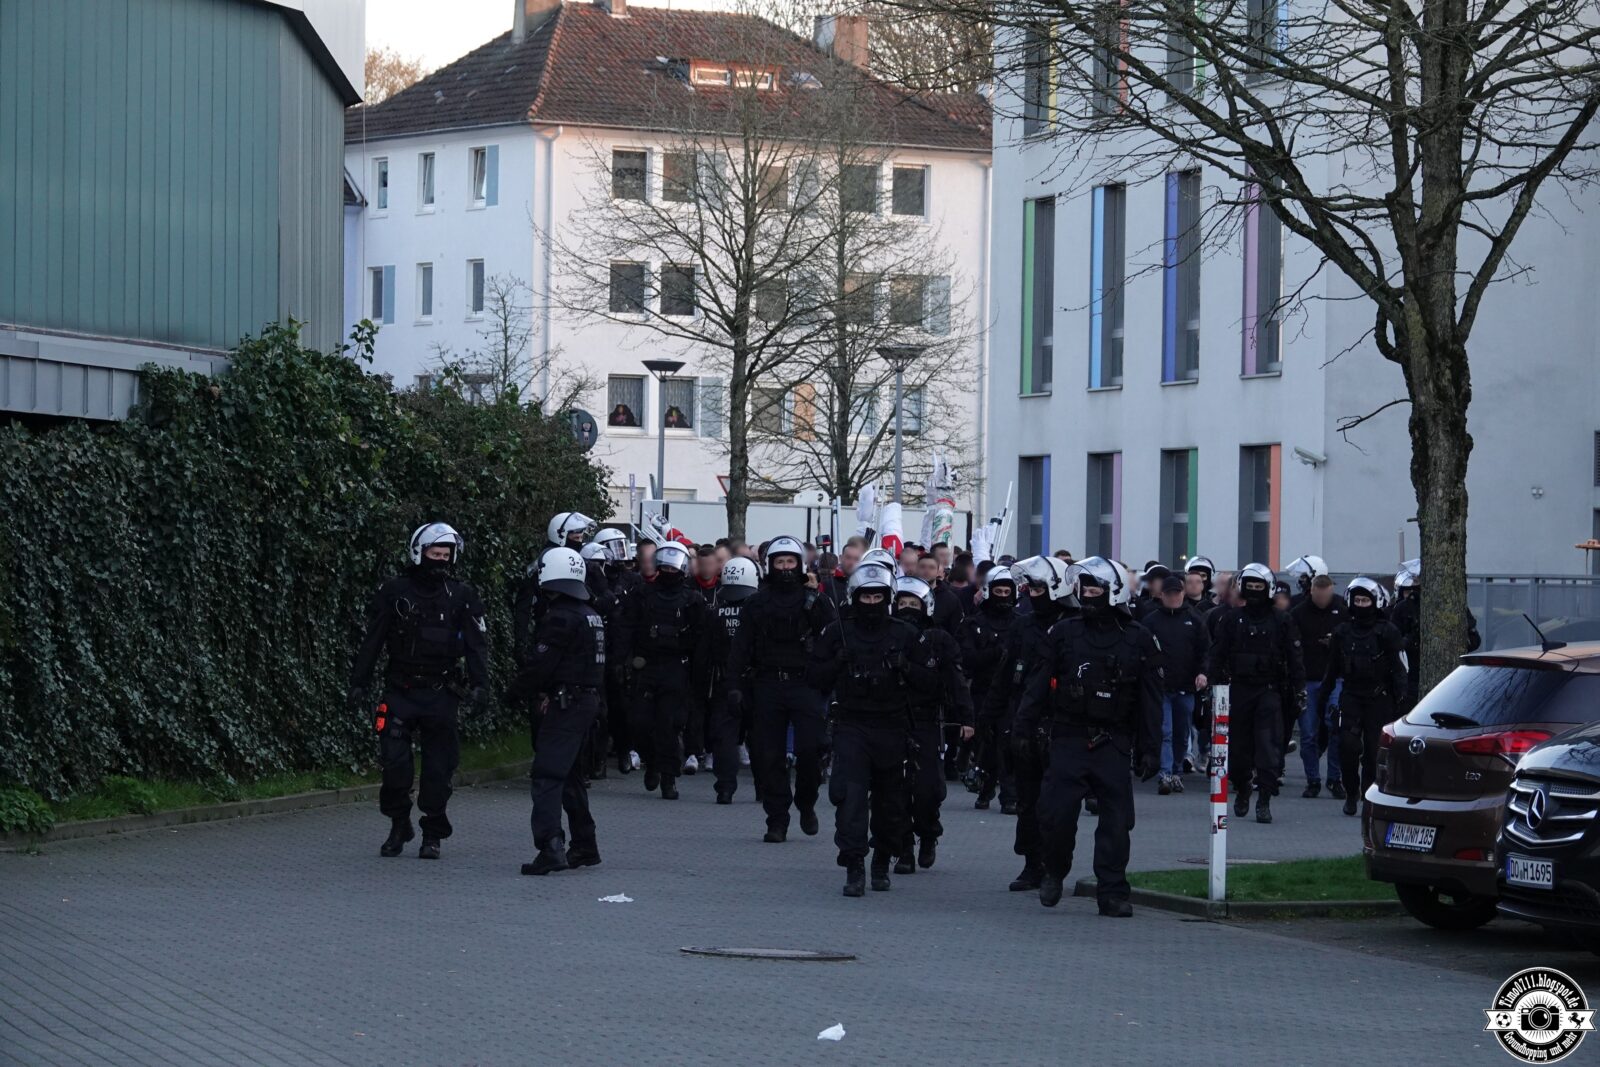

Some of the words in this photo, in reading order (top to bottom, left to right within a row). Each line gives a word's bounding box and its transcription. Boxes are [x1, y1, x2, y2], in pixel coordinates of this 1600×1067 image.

[723, 566, 745, 576] 3-2-1
[718, 606, 743, 617] POLI
[1511, 859, 1520, 878] DO
[1523, 861, 1529, 880] H
[1530, 863, 1552, 882] 1695
